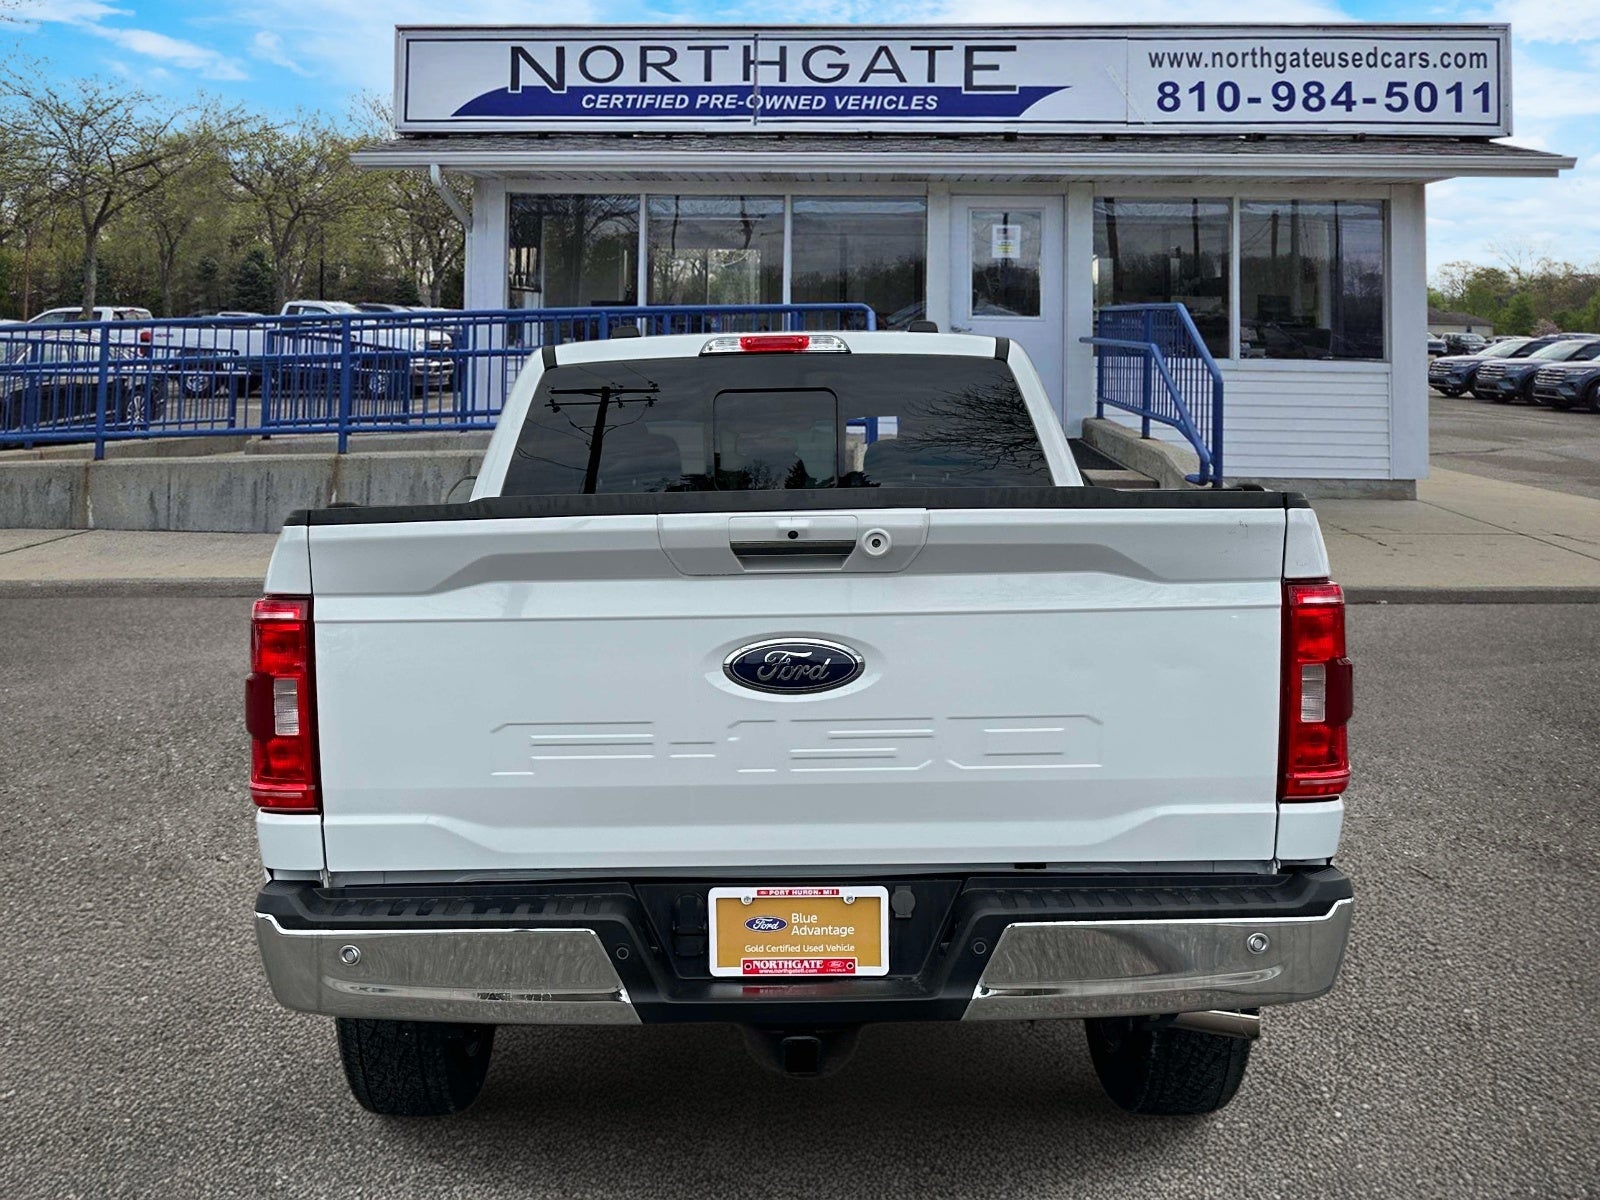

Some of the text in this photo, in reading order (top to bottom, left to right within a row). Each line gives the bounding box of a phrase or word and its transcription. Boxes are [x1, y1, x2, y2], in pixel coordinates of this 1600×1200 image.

[1148, 46, 1488, 73] www.northgateusedcars.com
[510, 45, 1017, 92] NORTHGATE
[582, 94, 938, 110] CERTIFIED PRE-OWNED VEHICLES
[1156, 80, 1490, 113] 810-984-5011
[757, 650, 831, 681] Ford
[753, 918, 779, 930] Ford
[791, 912, 818, 924] Blue
[791, 925, 855, 937] Advantage
[744, 943, 855, 953] Gold Certified Used Vehicle
[752, 959, 824, 969] NORTHGATE
